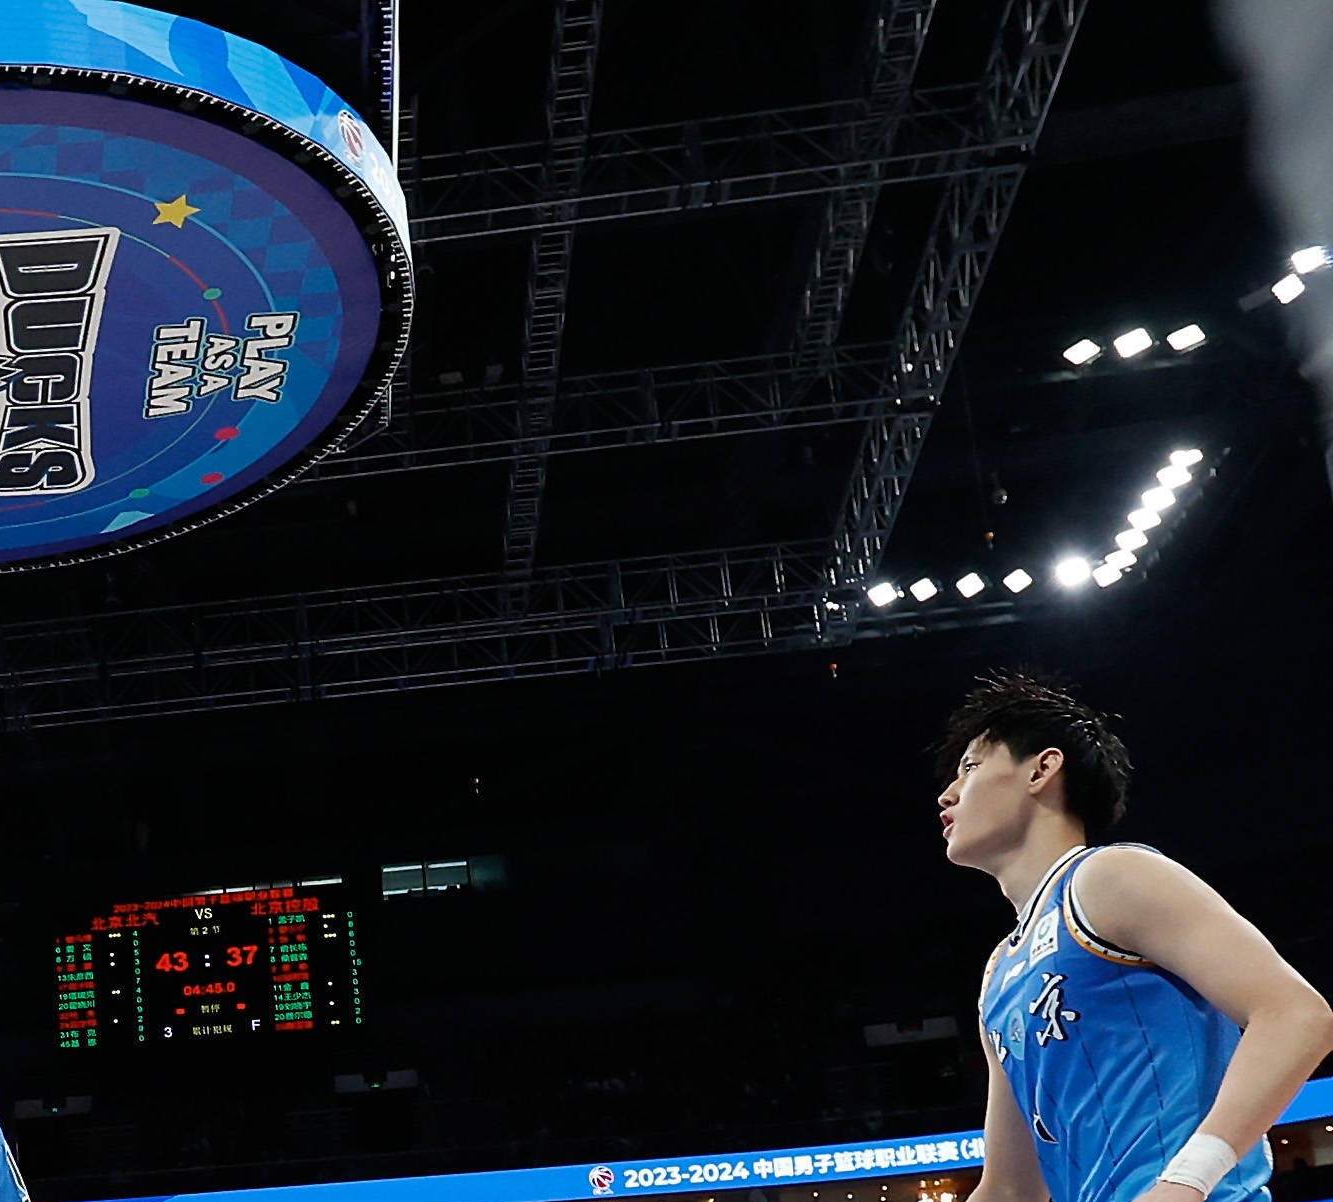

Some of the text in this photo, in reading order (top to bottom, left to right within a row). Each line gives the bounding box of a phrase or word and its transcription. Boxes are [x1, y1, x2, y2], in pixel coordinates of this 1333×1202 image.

[204, 335, 237, 370] AS
[238, 313, 297, 401] PLAY
[145, 320, 201, 417] TEAM
[194, 908, 213, 920] VS
[156, 952, 189, 971] 43
[227, 946, 258, 966] 37
[164, 1027, 173, 1037] 3
[252, 1020, 260, 1030] F
[624, 1164, 750, 1188] 2023-2024
